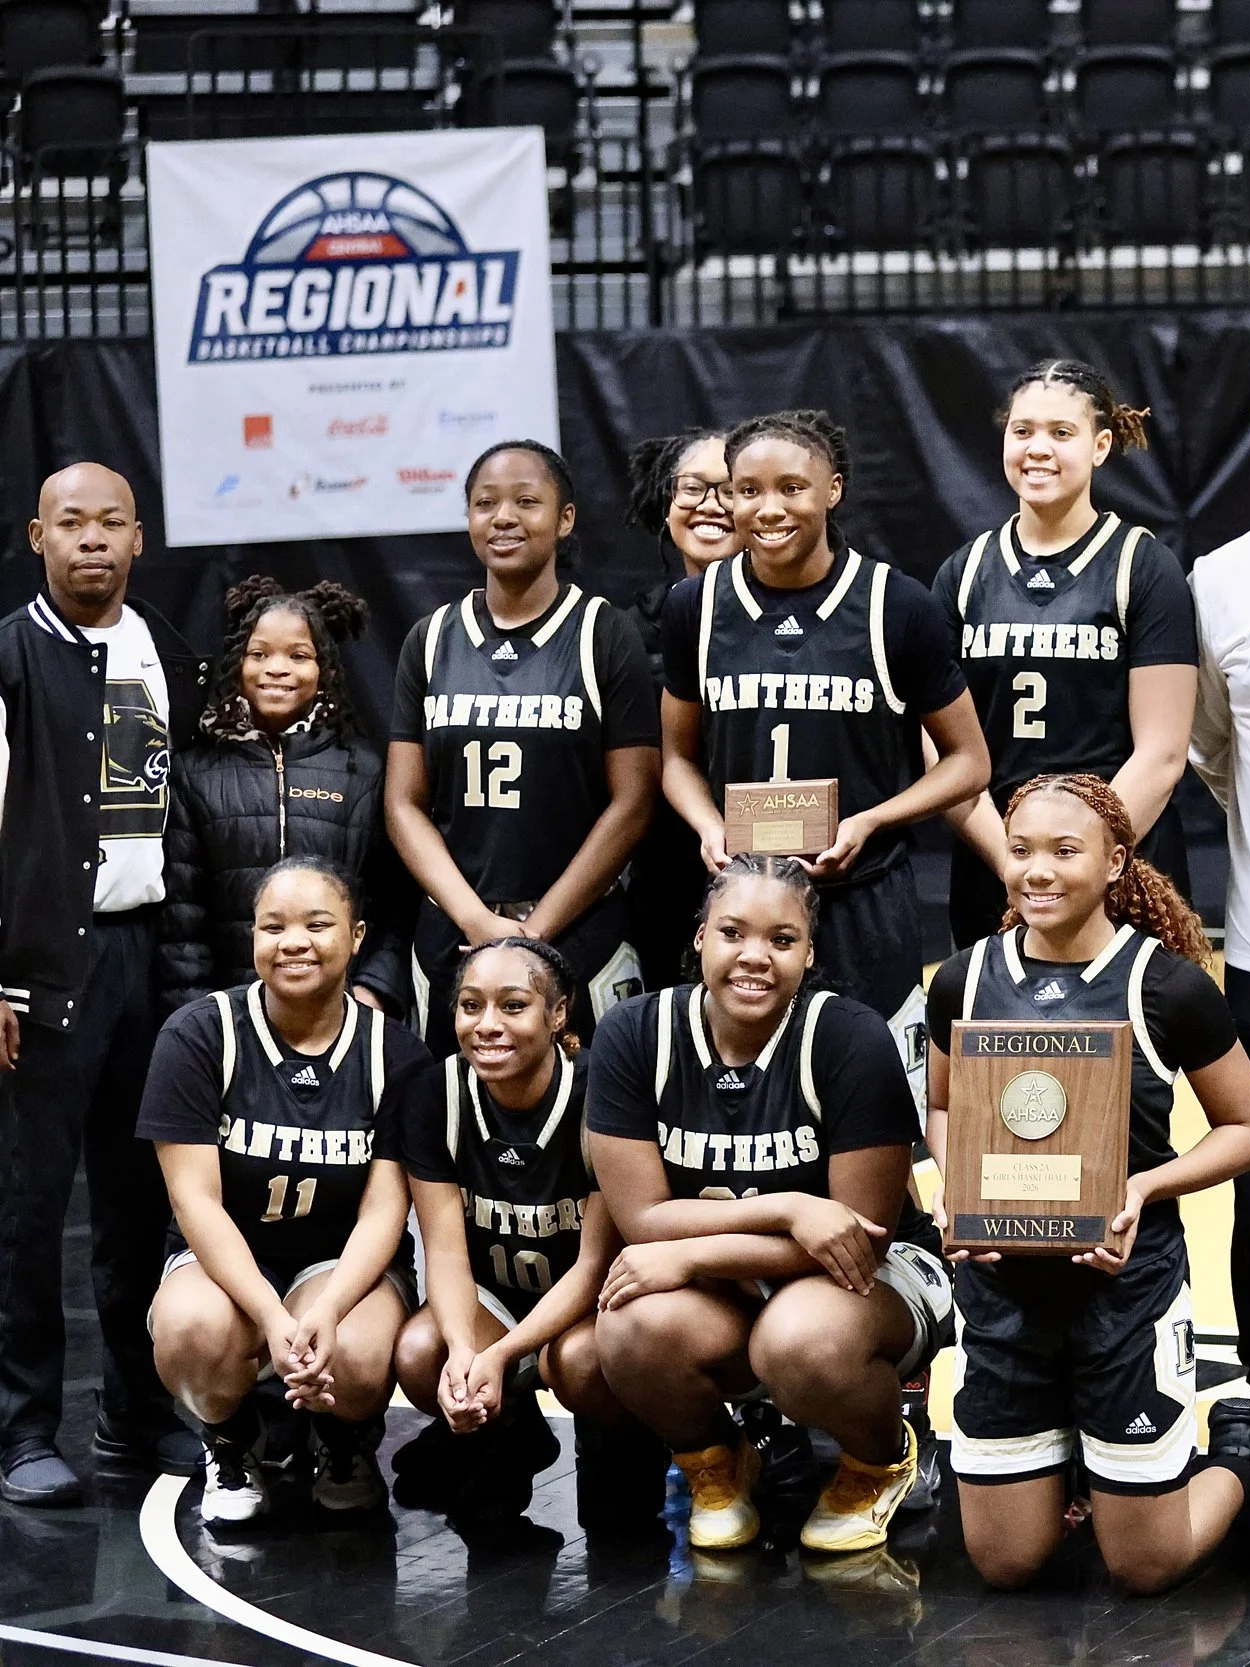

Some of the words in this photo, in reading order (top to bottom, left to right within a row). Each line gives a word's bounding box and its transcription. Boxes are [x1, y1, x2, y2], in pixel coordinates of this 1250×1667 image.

[320, 211, 391, 235] AHSAA
[205, 260, 513, 337] REGIONAL
[195, 333, 330, 361] BASKETBALL
[339, 322, 510, 354] CHAMPIONSHIPS
[1026, 580, 1056, 589] adidas
[774, 627, 804, 636] adidas
[961, 622, 1120, 661] PANTHERS
[491, 651, 520, 661] adidas
[705, 673, 875, 713] PANTHERS
[423, 692, 584, 731] PANTHERS
[1012, 671, 1048, 739] 2
[769, 723, 791, 783] 1
[462, 739, 523, 809] 12
[288, 785, 344, 803] bebe
[763, 792, 820, 810] AHSAA
[1034, 992, 1065, 1001] adidas
[976, 1034, 1098, 1054] REGIONAL
[291, 1075, 320, 1087] adidas
[716, 1081, 746, 1090] adidas
[1006, 1107, 1060, 1122] AHSAA
[218, 1113, 375, 1166] PANTHERS
[657, 1120, 820, 1172] PANTHERS
[498, 1155, 525, 1166] adidas
[260, 1175, 318, 1223] 11
[983, 1218, 1077, 1239] WINNER
[488, 1244, 550, 1294] 10
[1125, 1424, 1157, 1435] adidas
